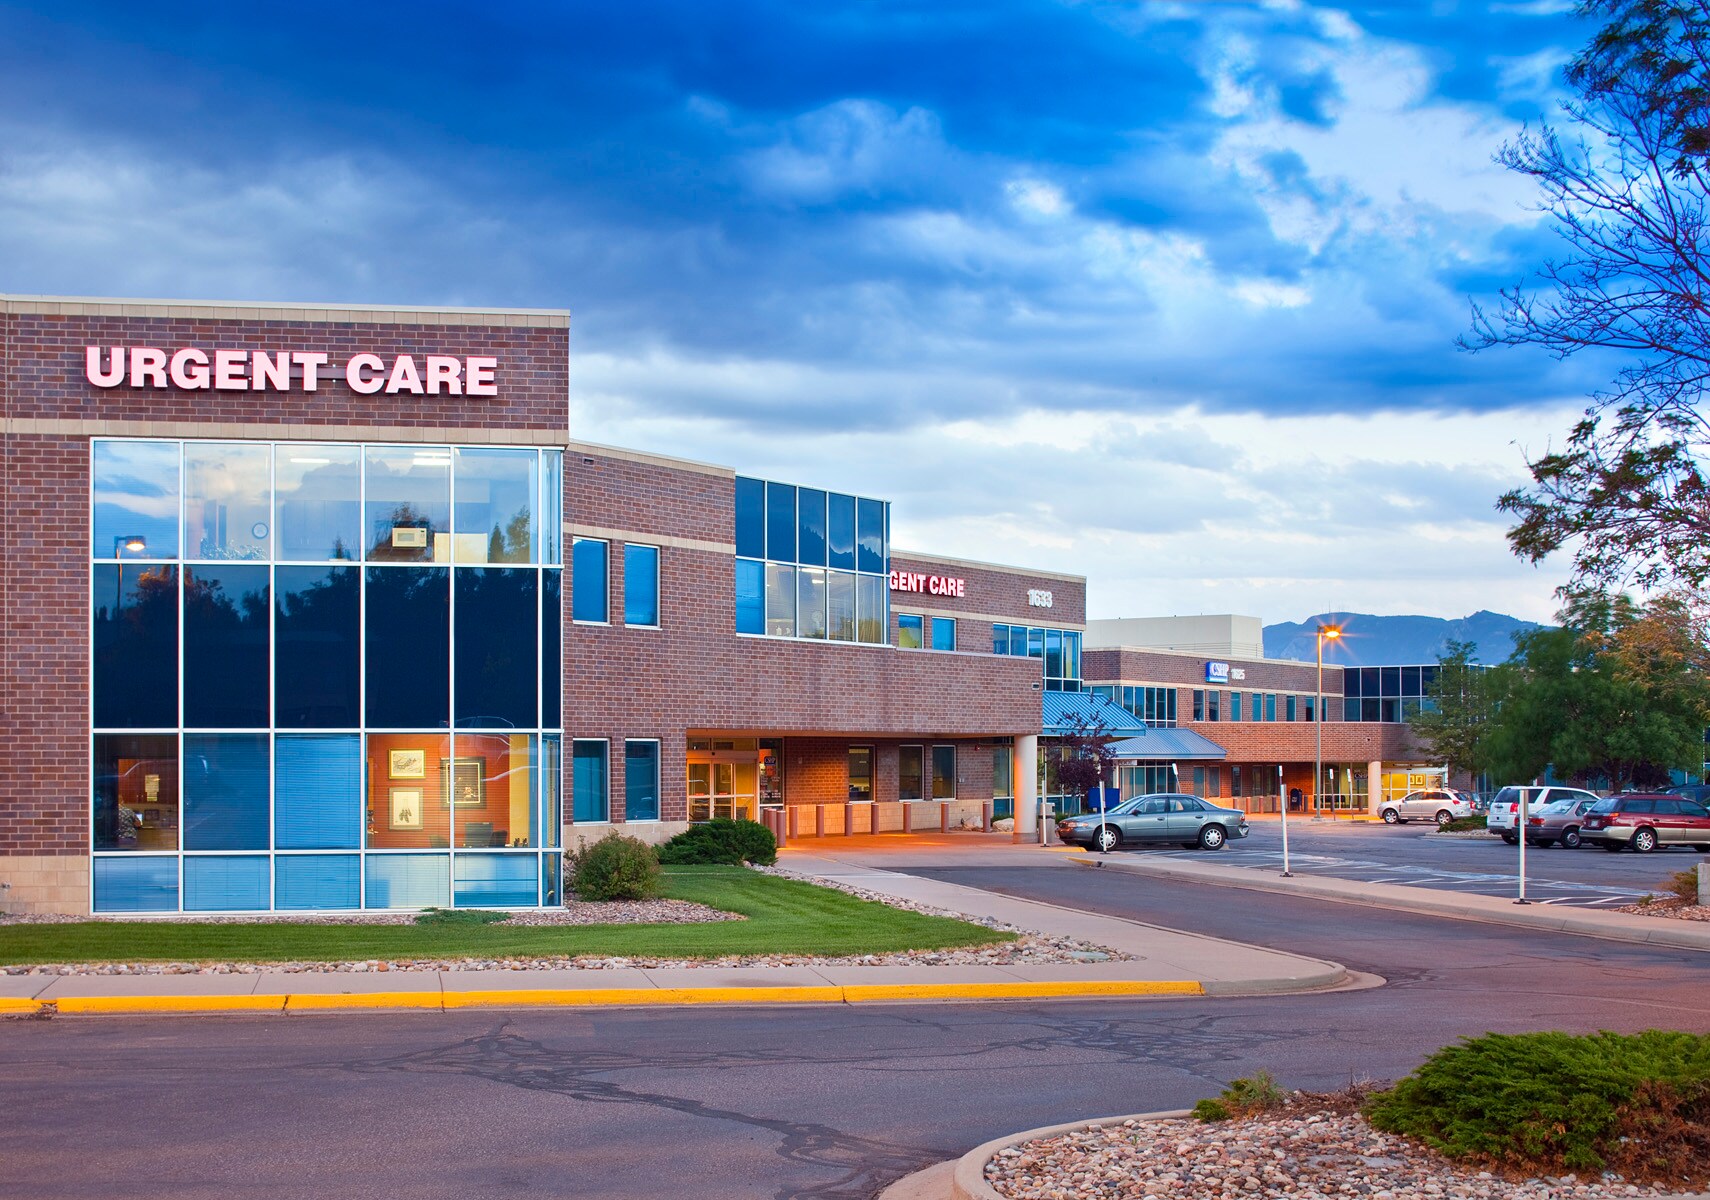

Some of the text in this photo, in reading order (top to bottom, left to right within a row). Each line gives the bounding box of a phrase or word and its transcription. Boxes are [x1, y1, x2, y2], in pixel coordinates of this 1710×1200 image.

[86, 345, 498, 397] URGENT CARE
[889, 570, 965, 598] GENT CARE
[1027, 589, 1053, 609] 1633
